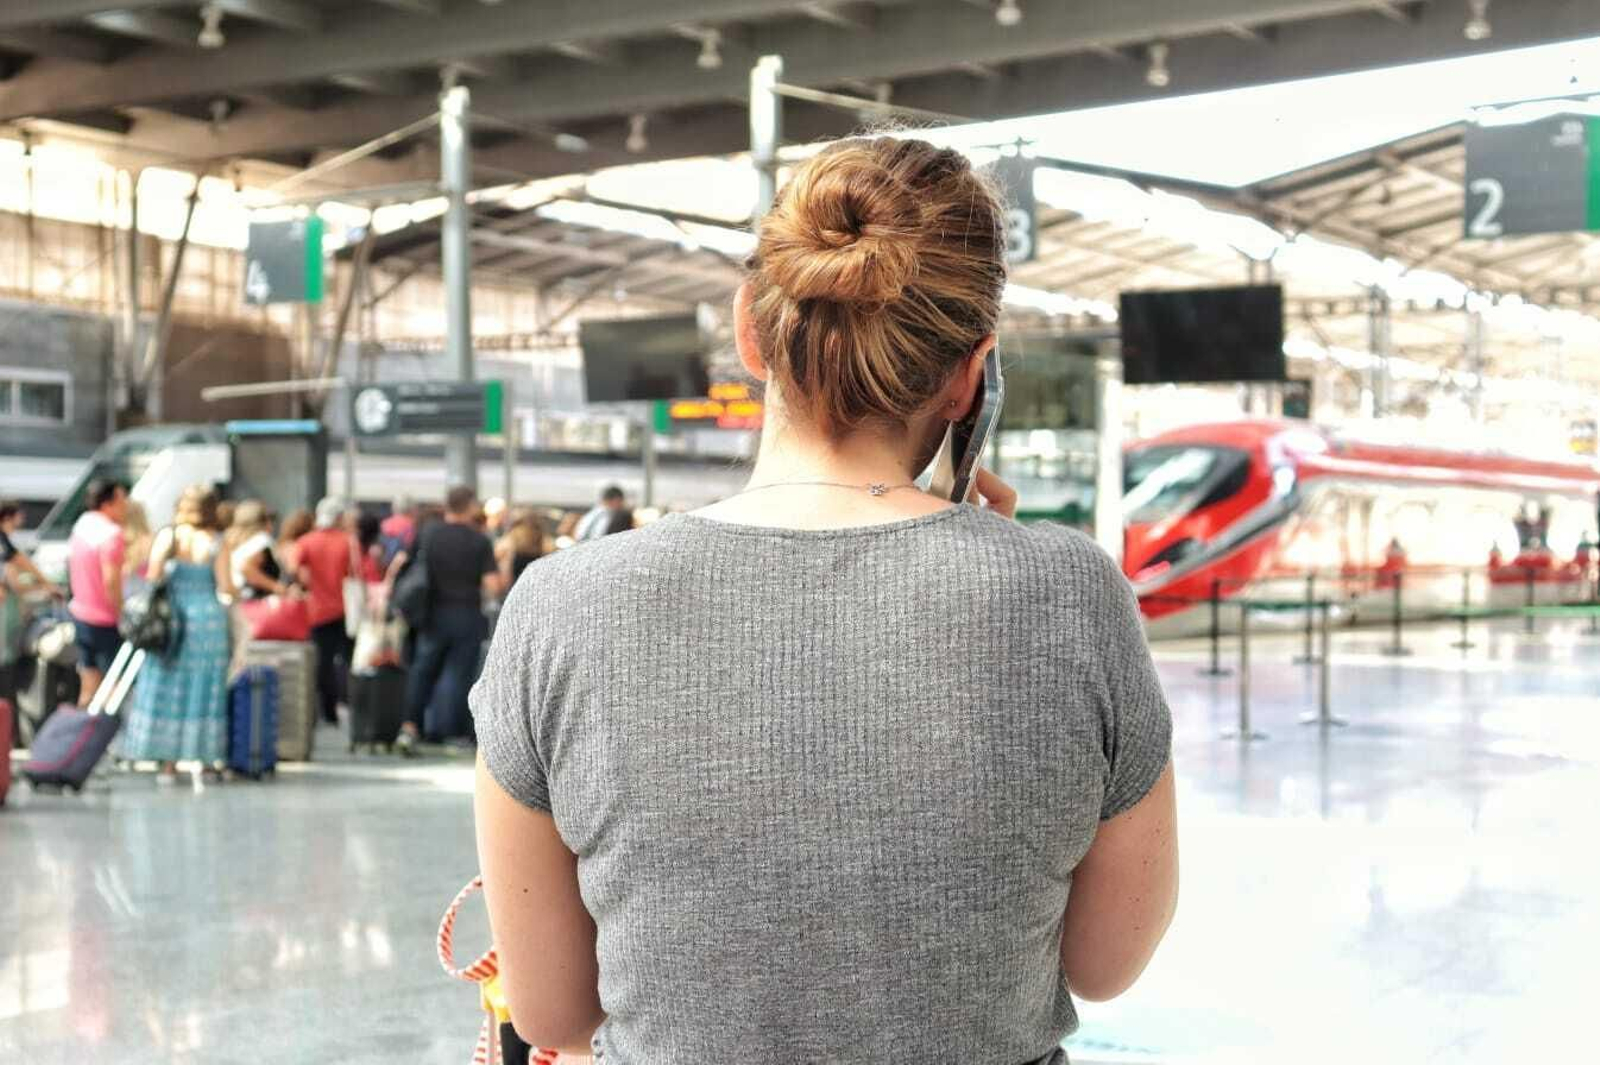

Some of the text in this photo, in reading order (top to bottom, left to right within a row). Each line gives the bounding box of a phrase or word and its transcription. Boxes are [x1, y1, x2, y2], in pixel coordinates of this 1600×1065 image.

[1469, 177, 1504, 235] 2
[1001, 207, 1032, 262] 3
[247, 259, 270, 302] 4
